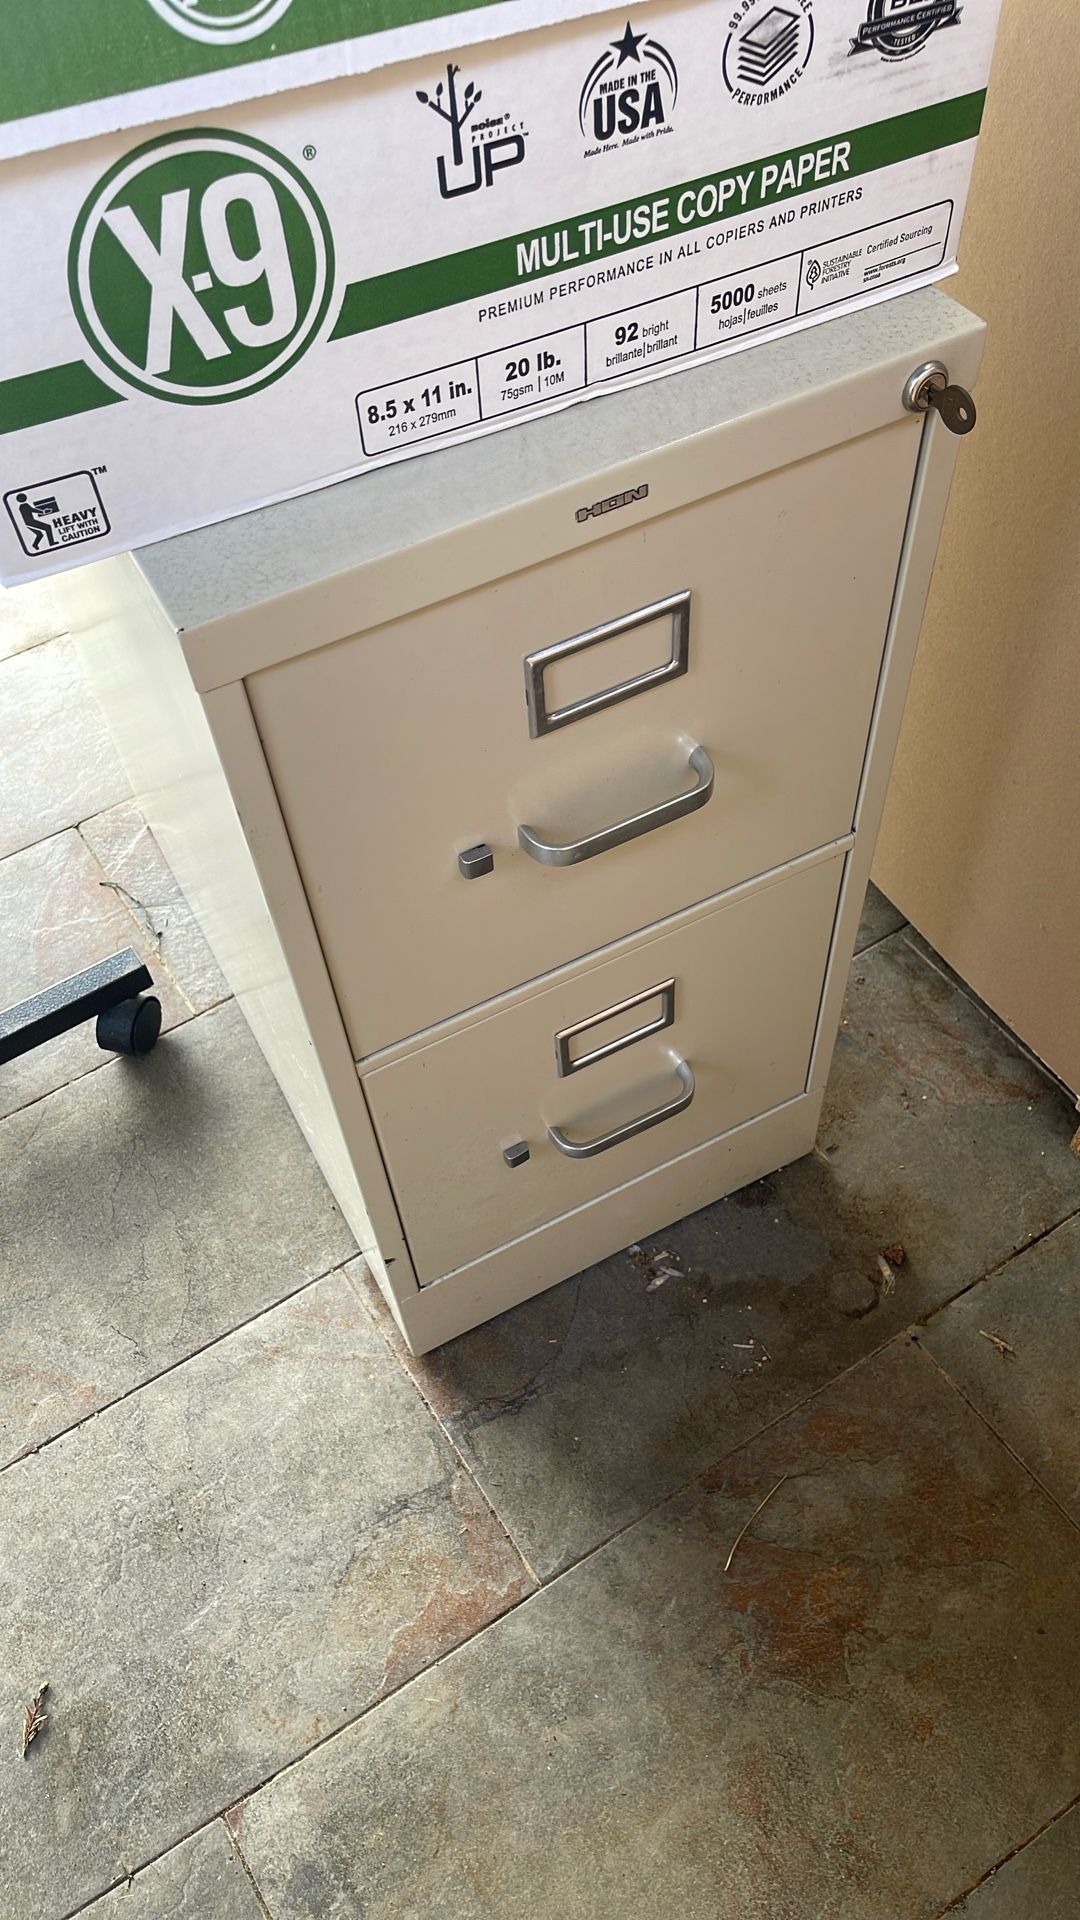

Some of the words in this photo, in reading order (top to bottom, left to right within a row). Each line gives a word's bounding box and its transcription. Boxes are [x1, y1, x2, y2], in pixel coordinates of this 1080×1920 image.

[862, 14, 915, 35] PERFORMANCE
[916, 4, 953, 20] CERTIFIED
[893, 34, 916, 46] TESTED
[600, 78, 625, 95] MADE
[628, 74, 638, 87] IN
[640, 69, 656, 83] THE
[732, 67, 803, 106] PERFORMANCE
[593, 81, 665, 141] USA
[471, 121, 524, 143] PROJECT
[584, 146, 601, 158] Made
[603, 141, 619, 153] Here.
[622, 134, 640, 147] Made
[641, 130, 655, 141] with
[656, 125, 674, 137] Pride.
[437, 134, 525, 199] UP
[516, 198, 670, 276] MULTI-USE
[677, 171, 756, 224] COPY
[761, 141, 851, 199] PAPER
[478, 291, 544, 322] PREMIUM
[549, 256, 654, 300] PERFORMANCE
[659, 250, 673, 265] IN
[677, 241, 701, 258] ALL
[706, 220, 764, 249] COPIERS
[769, 210, 796, 230] AND
[800, 187, 863, 219] PRINTERS
[866, 236, 898, 254] Certified
[900, 225, 932, 243] Sourcing
[101, 172, 298, 375] X-9
[822, 249, 862, 268] SUSTAINABLE
[822, 260, 851, 276] FORESTRY
[821, 268, 850, 284] INITIATIVE
[710, 283, 755, 314] 5000
[757, 281, 787, 299] sheets
[615, 322, 639, 346] 92
[642, 319, 669, 338] bright
[505, 357, 530, 382] 20
[537, 351, 561, 372] lb.
[500, 383, 533, 401] 75gsm
[544, 371, 565, 387] 10M
[367, 399, 397, 424] 8.5
[404, 396, 416, 414] x
[421, 385, 441, 407] 11
[448, 381, 473, 400] in.
[388, 422, 408, 437] 216
[410, 419, 417, 430] x
[419, 408, 456, 428] 279mm
[52, 507, 97, 528] HEAVY
[575, 484, 648, 523] HON
[58, 524, 75, 535] LIFT
[77, 518, 98, 529] WITH
[61, 526, 100, 542] CAUTION
